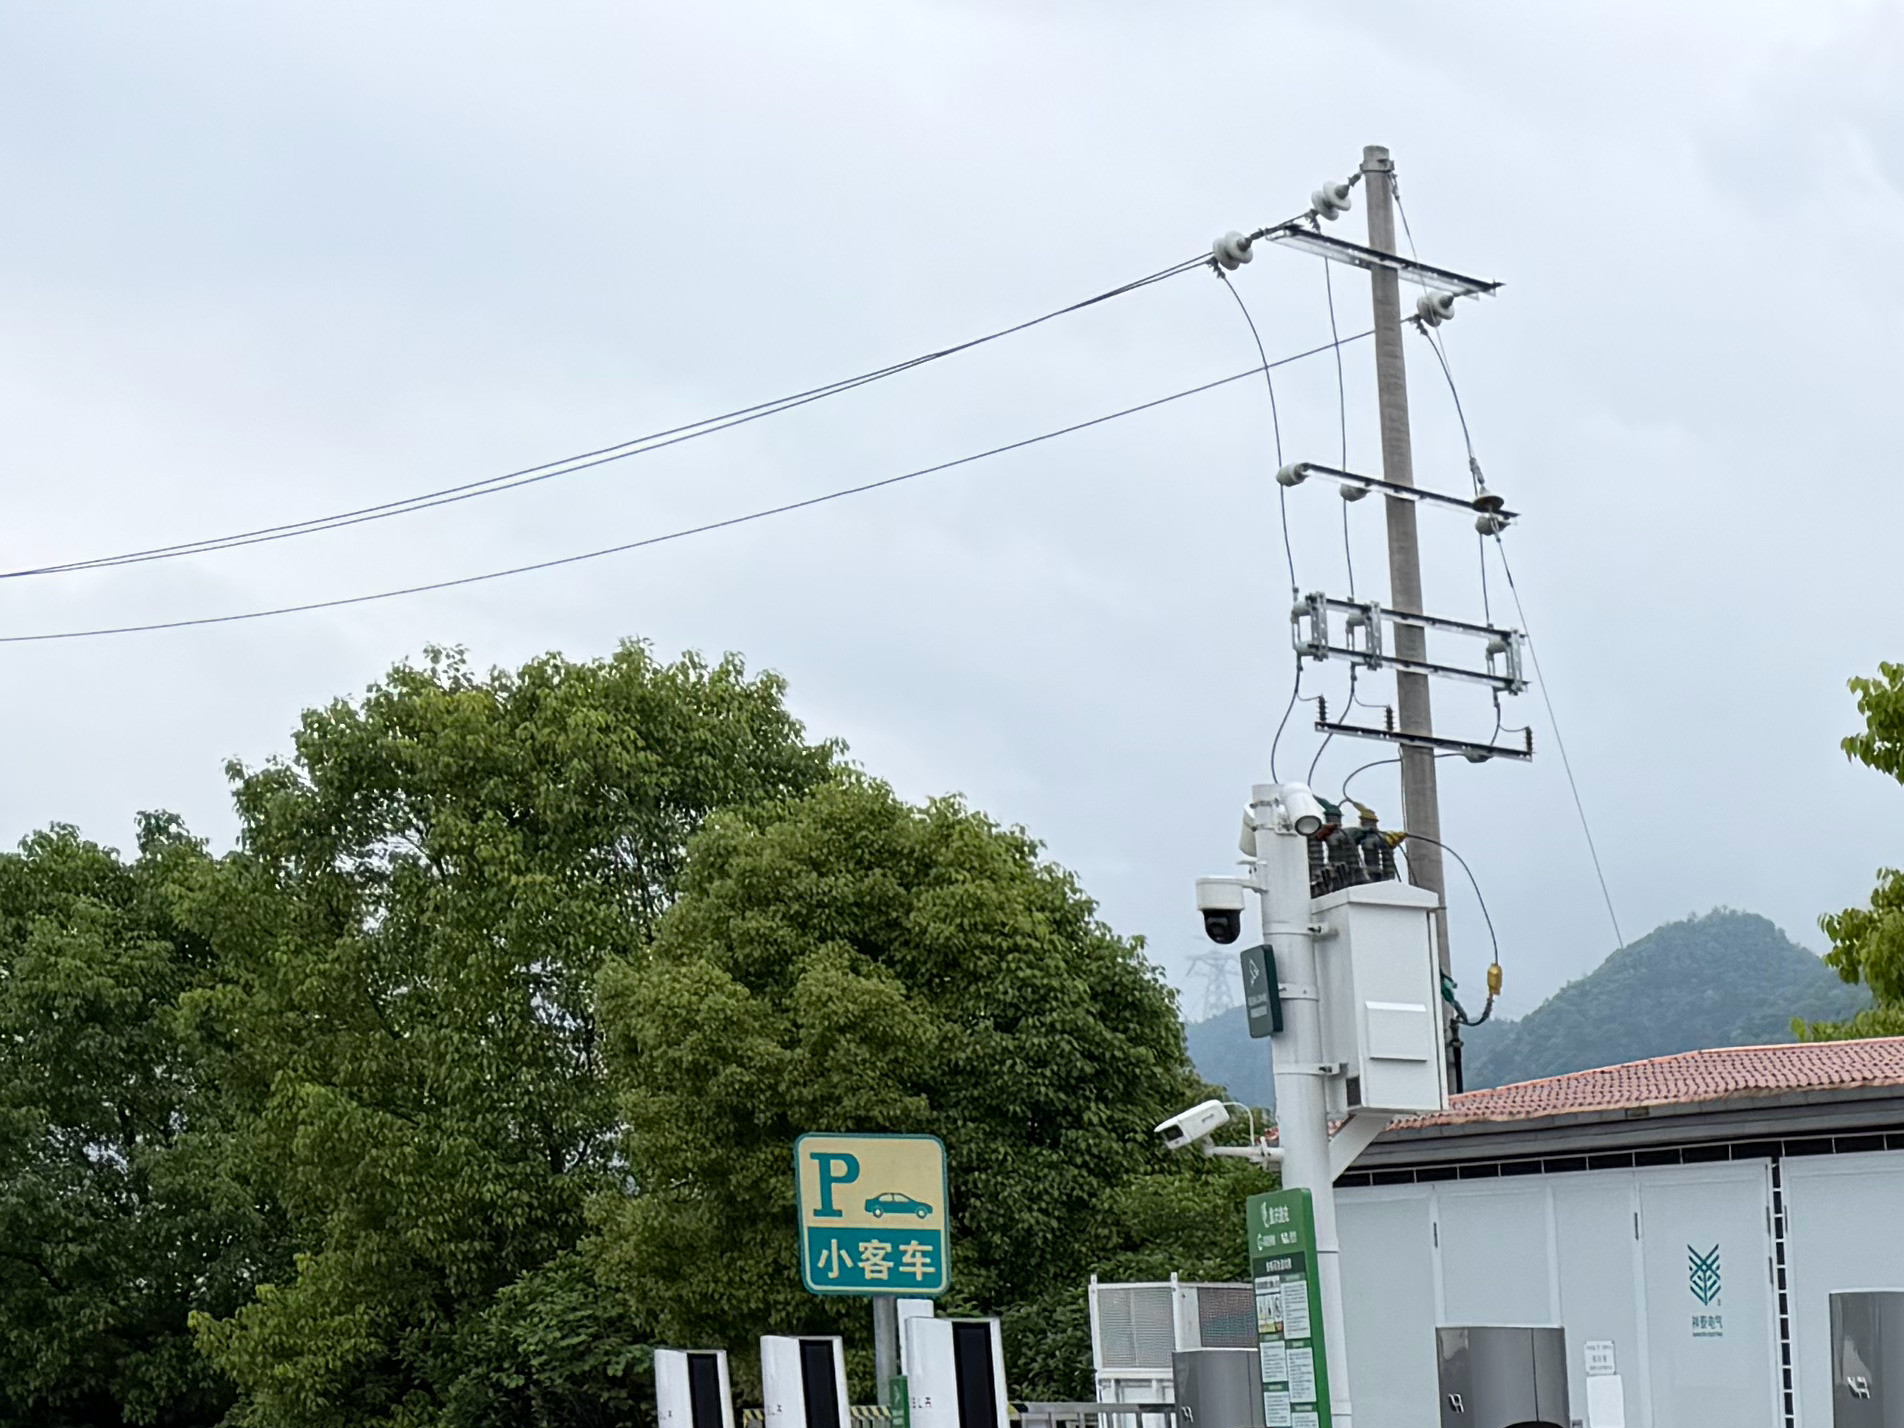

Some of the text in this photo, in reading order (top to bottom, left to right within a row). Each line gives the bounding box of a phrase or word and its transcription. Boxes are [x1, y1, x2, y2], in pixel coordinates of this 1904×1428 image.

[810, 1152, 860, 1217] P
[817, 1239, 935, 1280] 小客车
